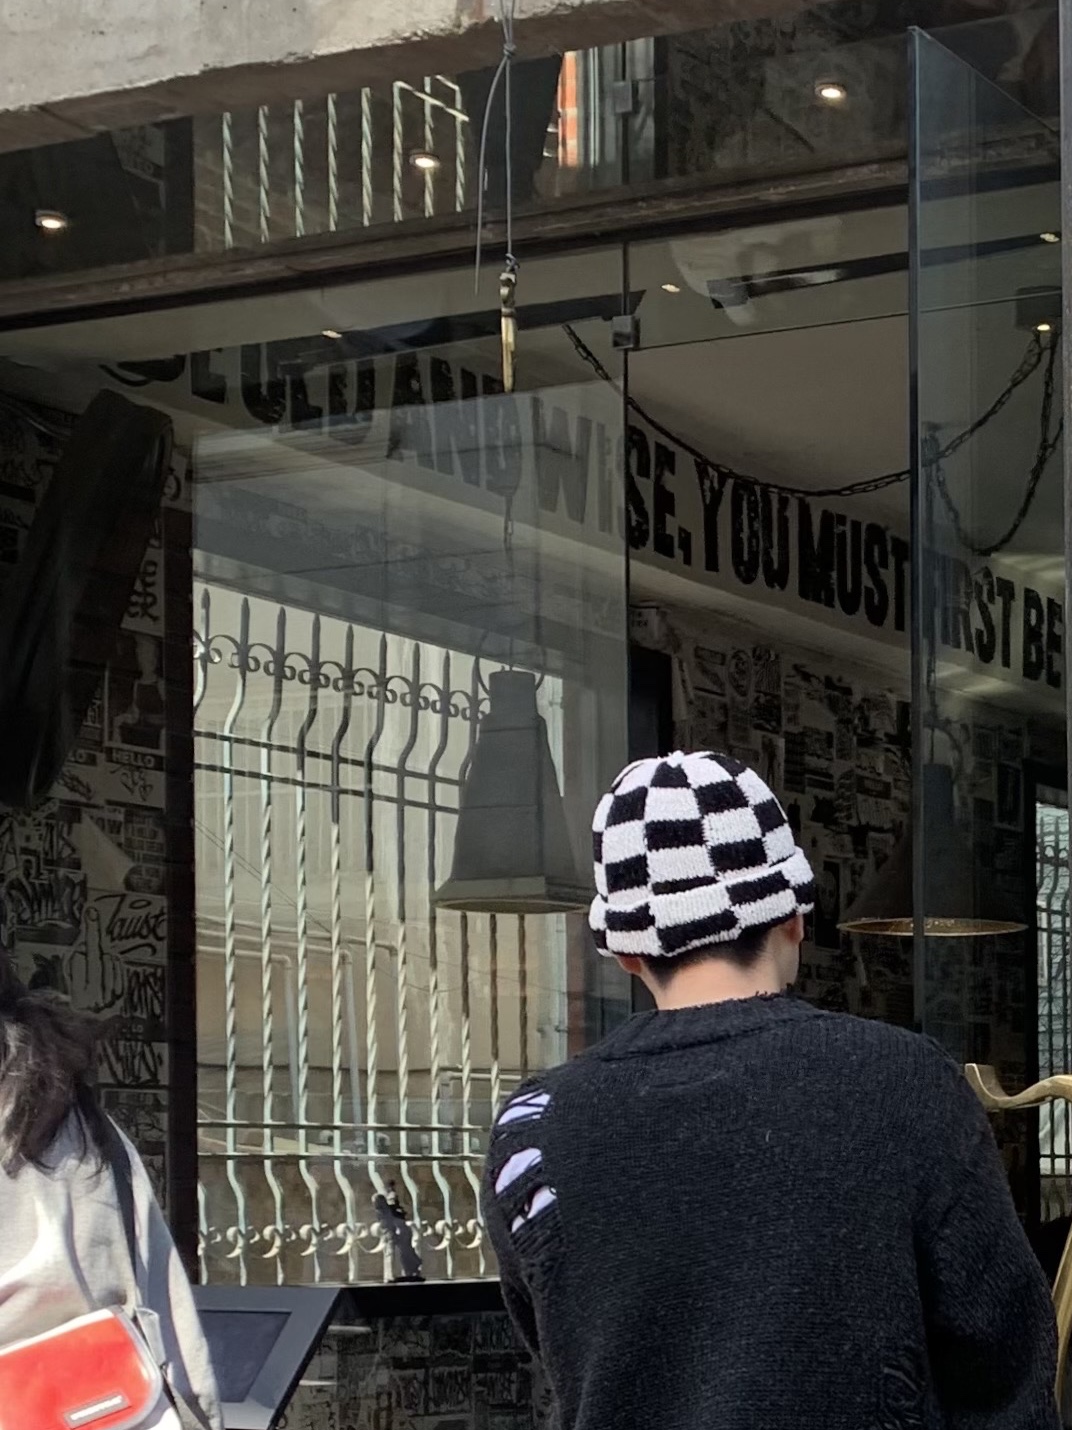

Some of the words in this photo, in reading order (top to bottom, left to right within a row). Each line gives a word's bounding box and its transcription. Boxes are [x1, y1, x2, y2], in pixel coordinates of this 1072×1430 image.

[695, 457, 790, 592] YOU
[798, 497, 912, 631] MUST
[1022, 586, 1064, 689] BE
